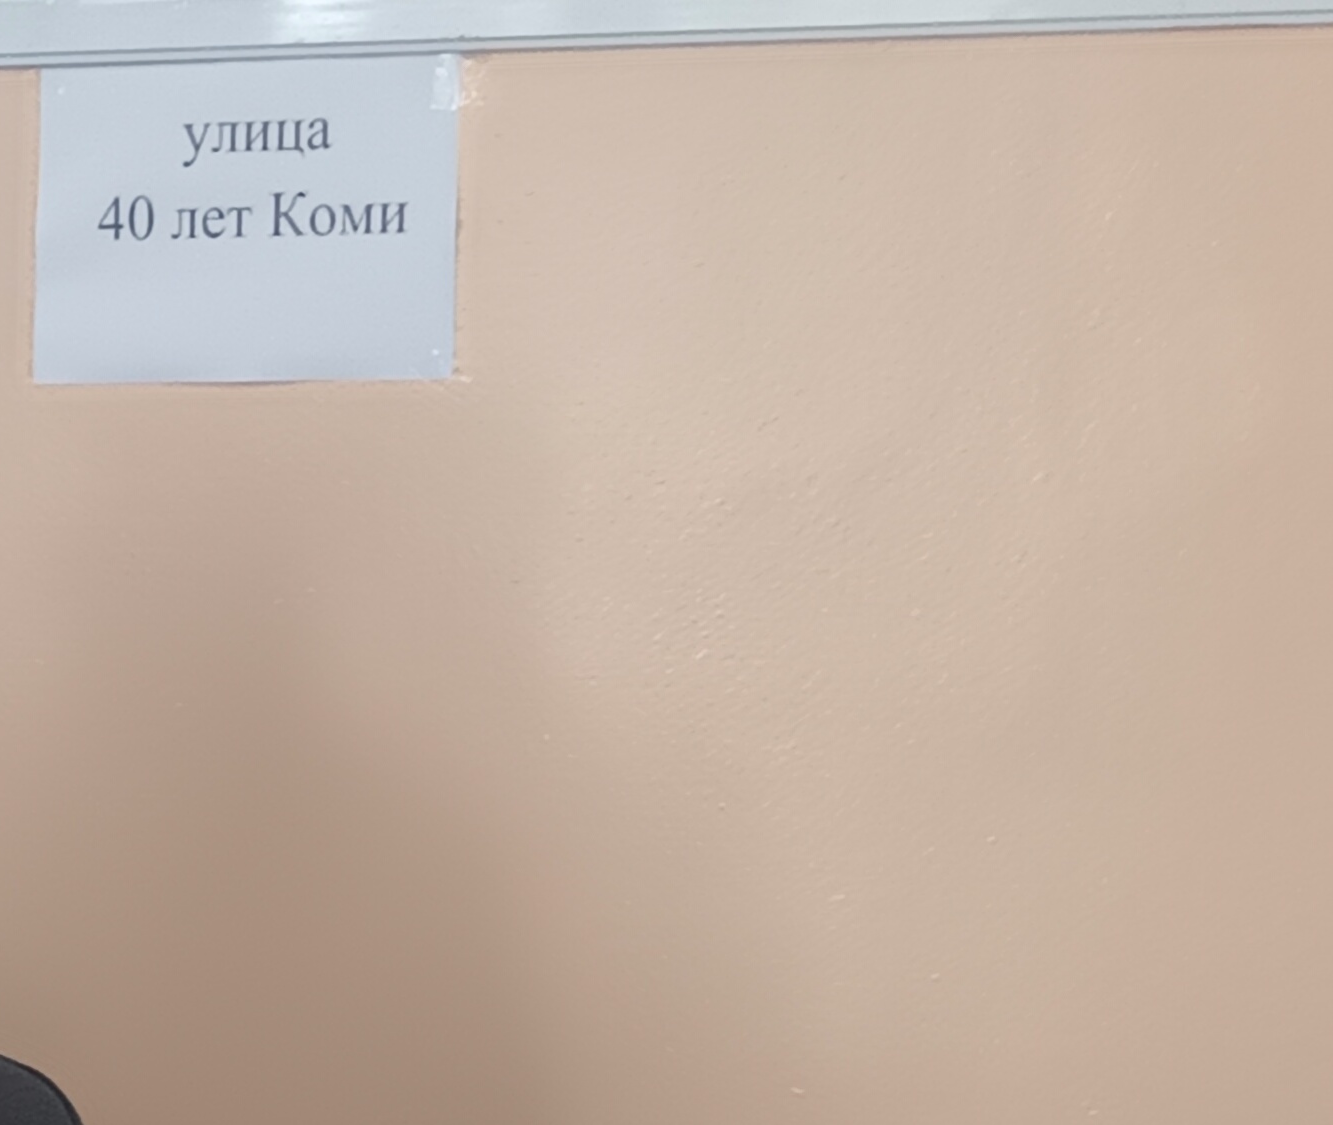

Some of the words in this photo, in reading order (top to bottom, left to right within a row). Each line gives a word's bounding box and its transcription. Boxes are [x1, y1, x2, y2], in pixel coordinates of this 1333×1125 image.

[182, 117, 332, 168] улица
[97, 195, 155, 241] 40
[170, 206, 253, 240] лет
[269, 190, 408, 238] Коми
